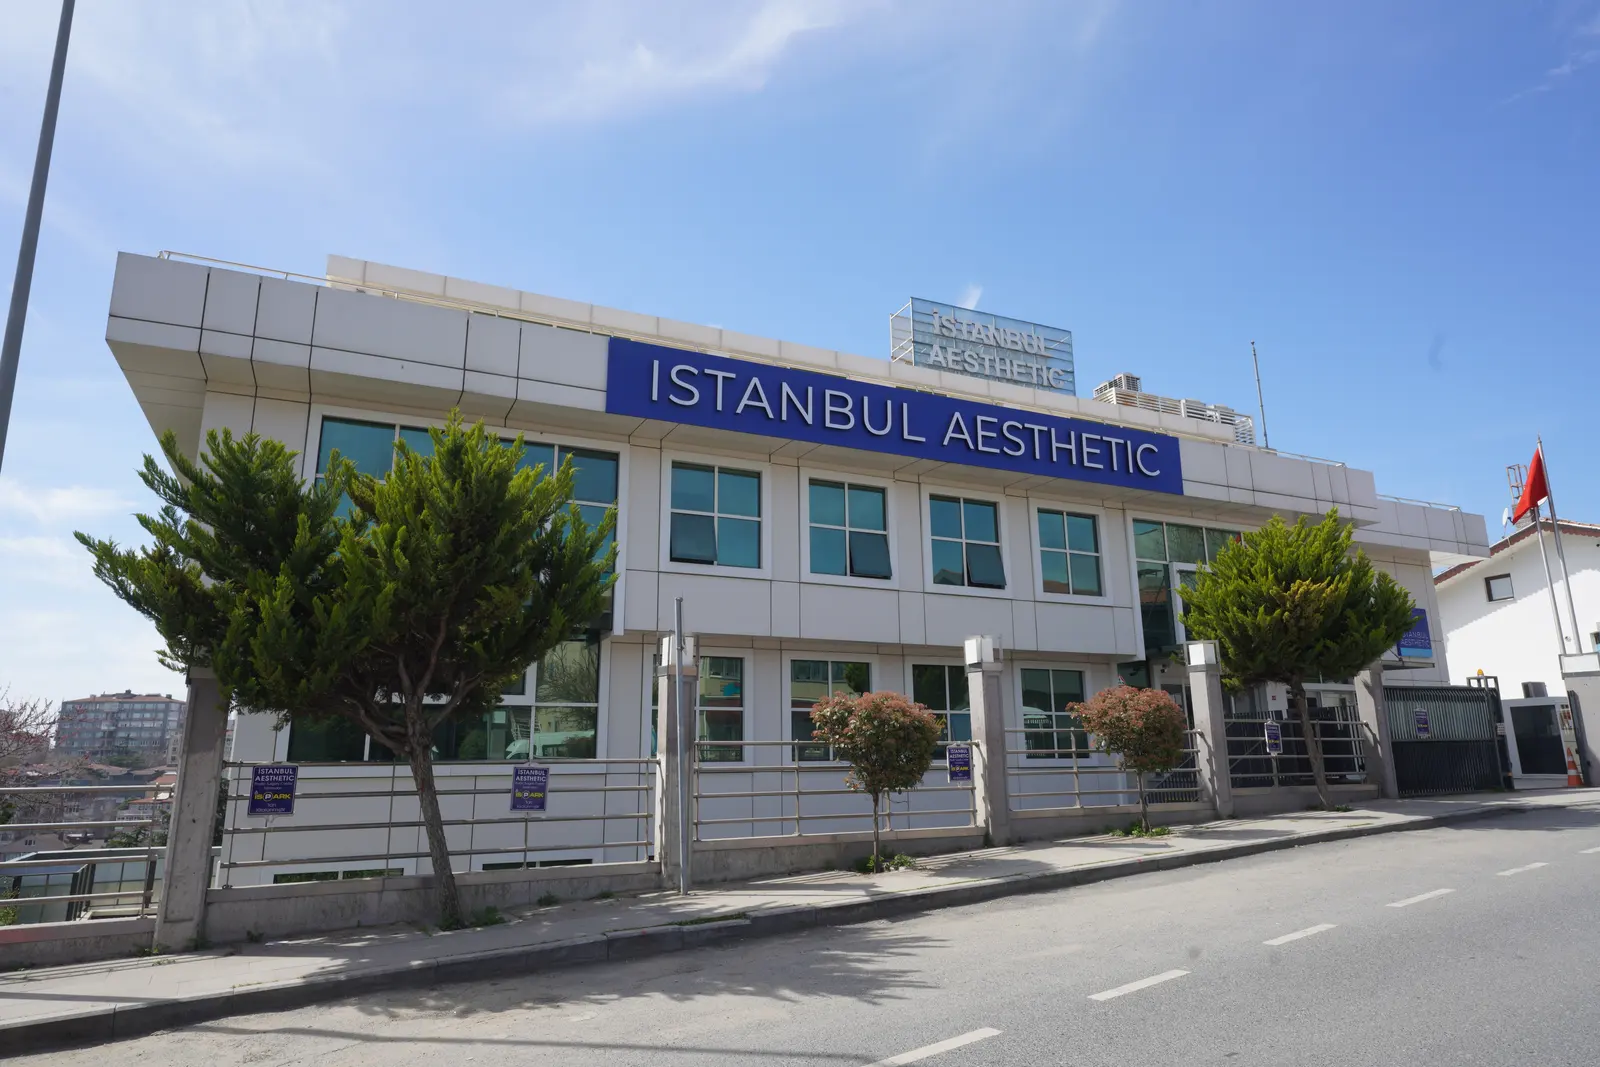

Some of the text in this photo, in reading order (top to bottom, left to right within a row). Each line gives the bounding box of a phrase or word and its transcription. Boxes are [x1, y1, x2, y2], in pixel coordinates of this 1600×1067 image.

[927, 345, 1064, 388] AESTHETIC
[651, 359, 1161, 477] ISTANBUL AESTHETIC
